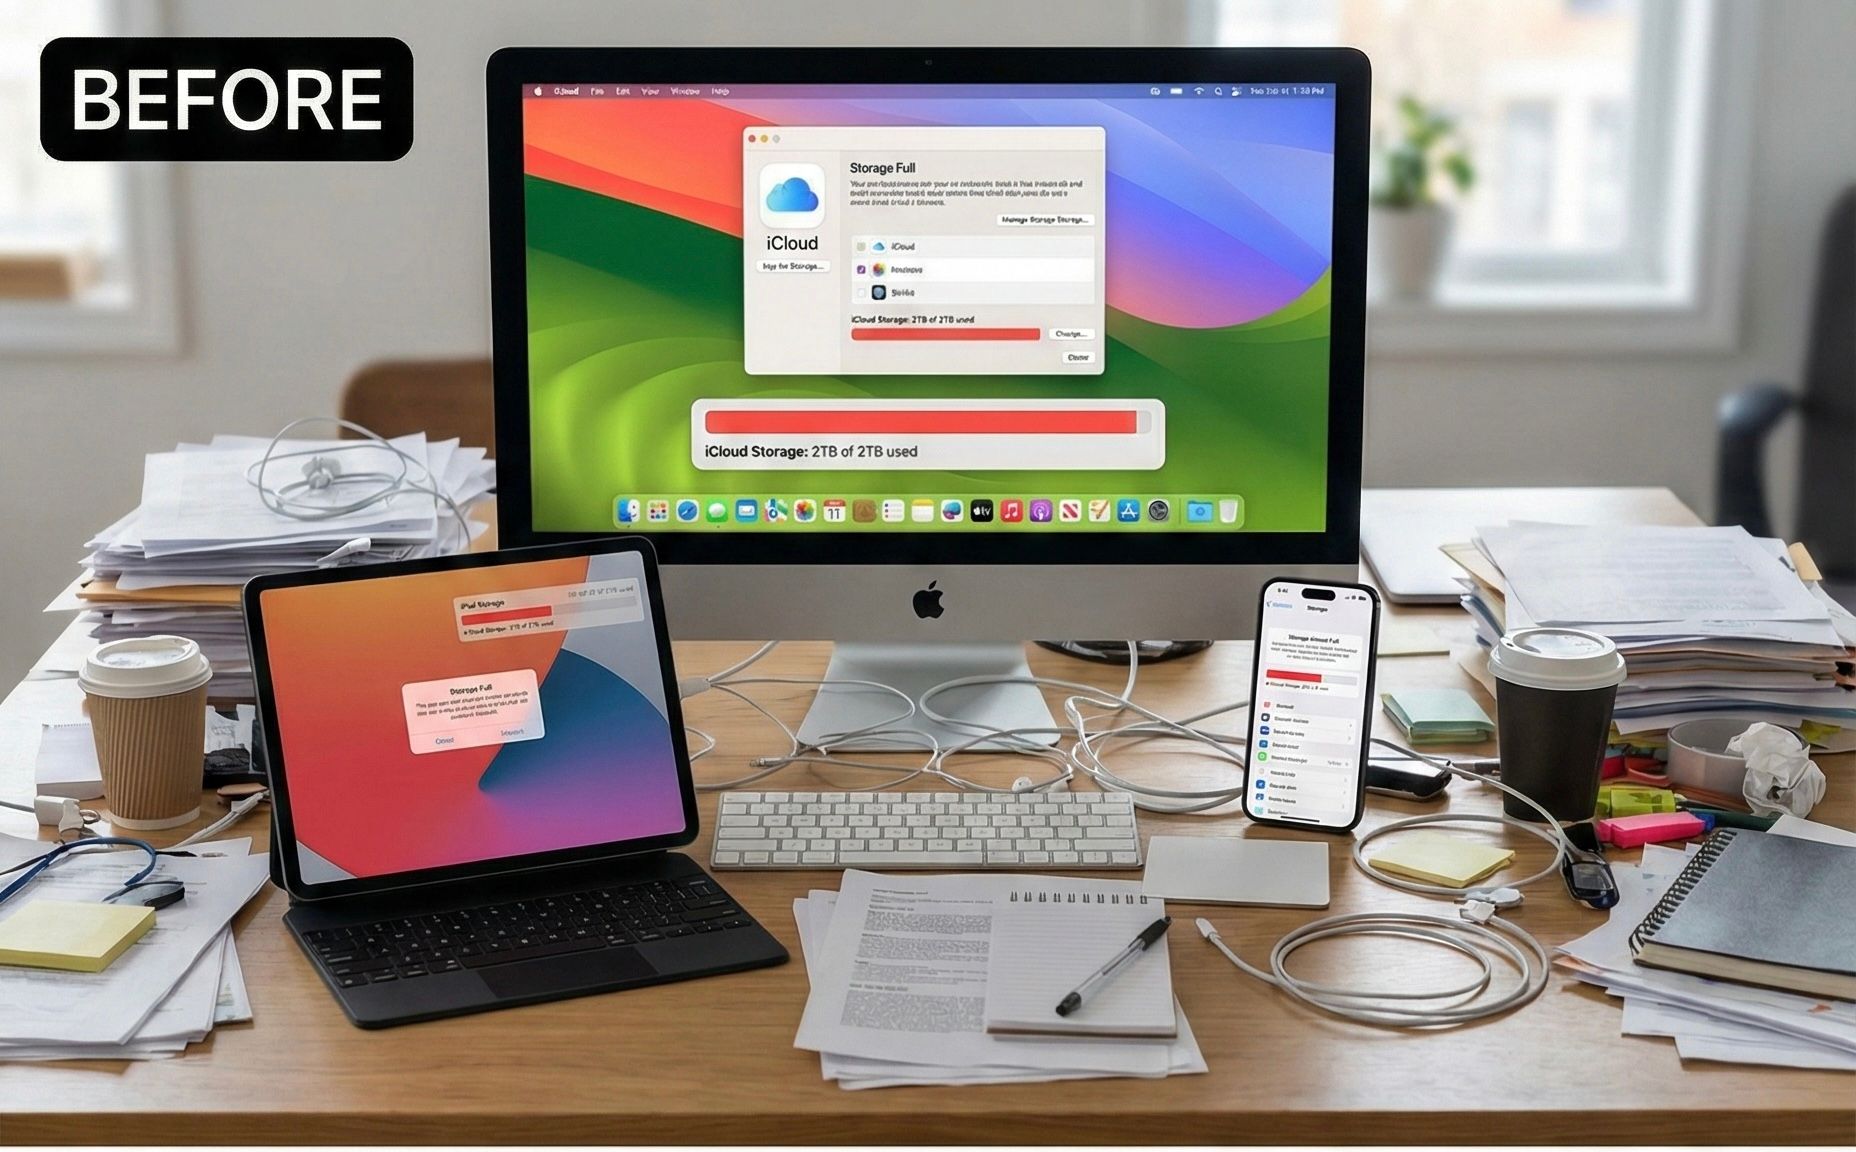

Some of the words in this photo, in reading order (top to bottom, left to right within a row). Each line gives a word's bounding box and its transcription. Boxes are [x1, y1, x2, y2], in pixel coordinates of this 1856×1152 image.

[850, 162, 893, 175] Storage
[896, 162, 916, 174] Full
[767, 235, 818, 251] iCloud
[911, 315, 928, 324] 2TB
[705, 445, 748, 458] iCloud
[751, 445, 809, 460] Storage:
[811, 445, 838, 458] 2TB
[841, 445, 854, 458] of
[857, 445, 884, 458] 2TB
[886, 445, 918, 458] used
